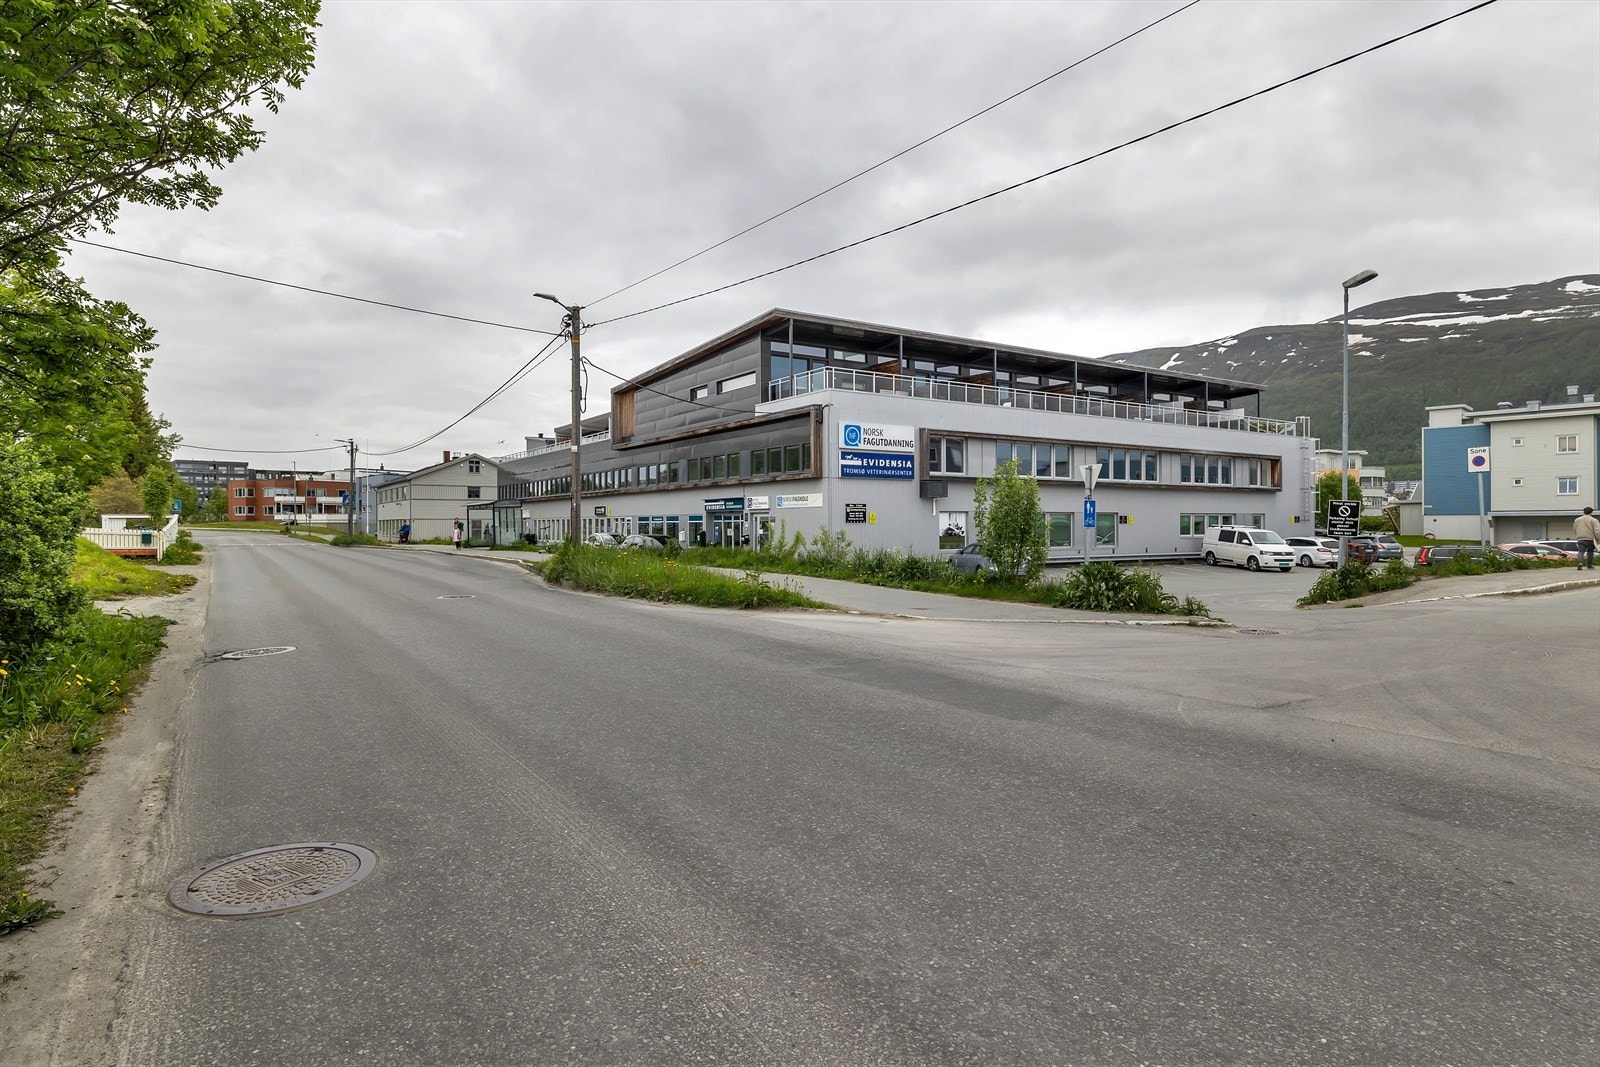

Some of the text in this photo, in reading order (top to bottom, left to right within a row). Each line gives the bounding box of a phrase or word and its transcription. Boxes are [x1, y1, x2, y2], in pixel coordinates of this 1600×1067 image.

[863, 428, 884, 436] NORSK
[863, 437, 914, 448] FAGUTDANNING
[863, 459, 912, 468] EVIDENSIA
